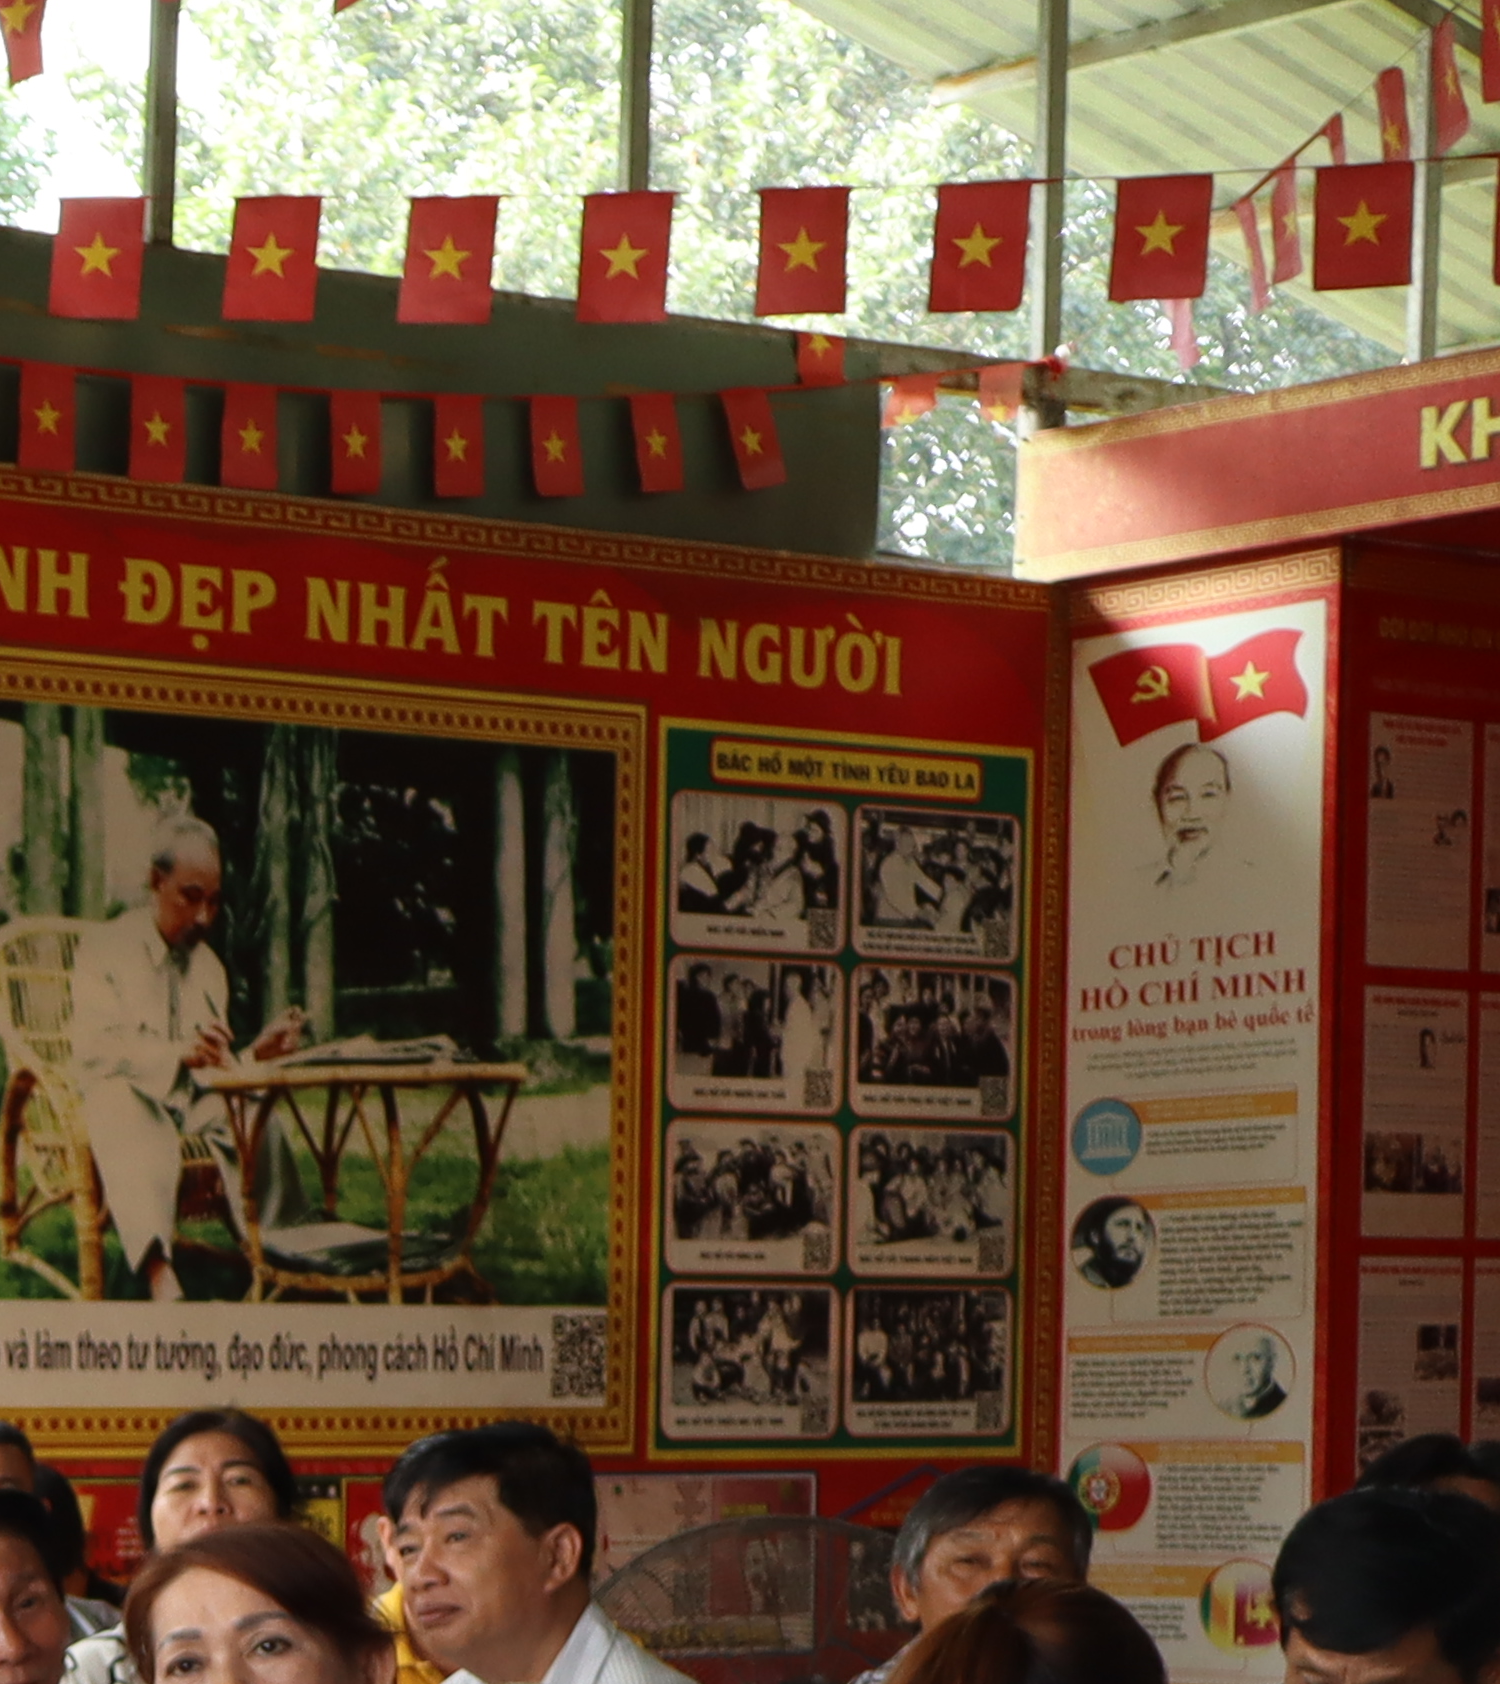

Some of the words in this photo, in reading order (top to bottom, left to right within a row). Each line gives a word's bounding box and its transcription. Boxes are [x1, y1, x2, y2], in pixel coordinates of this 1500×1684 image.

[1420, 396, 1500, 469] KH
[118, 557, 277, 651] ĐẸP
[306, 556, 508, 658] NHẤT
[533, 589, 669, 674] TÊN
[698, 613, 904, 696] NGƯỜI
[715, 751, 752, 774] BÁC
[757, 750, 783, 776] HỒ
[787, 755, 824, 781] MỘT
[831, 761, 871, 782] TÌNH
[876, 763, 910, 786] YÊU
[914, 769, 950, 789] BAO
[954, 772, 976, 792] LA
[1109, 933, 1181, 971] CHỦ
[1191, 931, 1277, 967] TỊCH
[1080, 975, 1130, 1013] HỒ
[1139, 971, 1200, 1008] CHÍ
[1213, 969, 1307, 1000] MINH
[1071, 1022, 1122, 1044] trong
[1127, 1018, 1169, 1040] lòng
[1173, 1014, 1210, 1037] bạn
[1214, 1012, 1238, 1032] bè
[1244, 1006, 1291, 1033] quốc
[1296, 1001, 1316, 1024] tế
[5, 1329, 29, 1371] và
[35, 1331, 72, 1371] làm
[76, 1331, 123, 1371] theo
[126, 1334, 151, 1372] tư
[154, 1330, 222, 1383] tưởng,
[226, 1332, 265, 1381] đạo
[267, 1331, 313, 1377] đức,
[316, 1332, 379, 1384] phong
[381, 1332, 429, 1374] cách
[431, 1327, 460, 1373] Hồ
[461, 1329, 497, 1373] Chí
[497, 1332, 546, 1373] Minh
